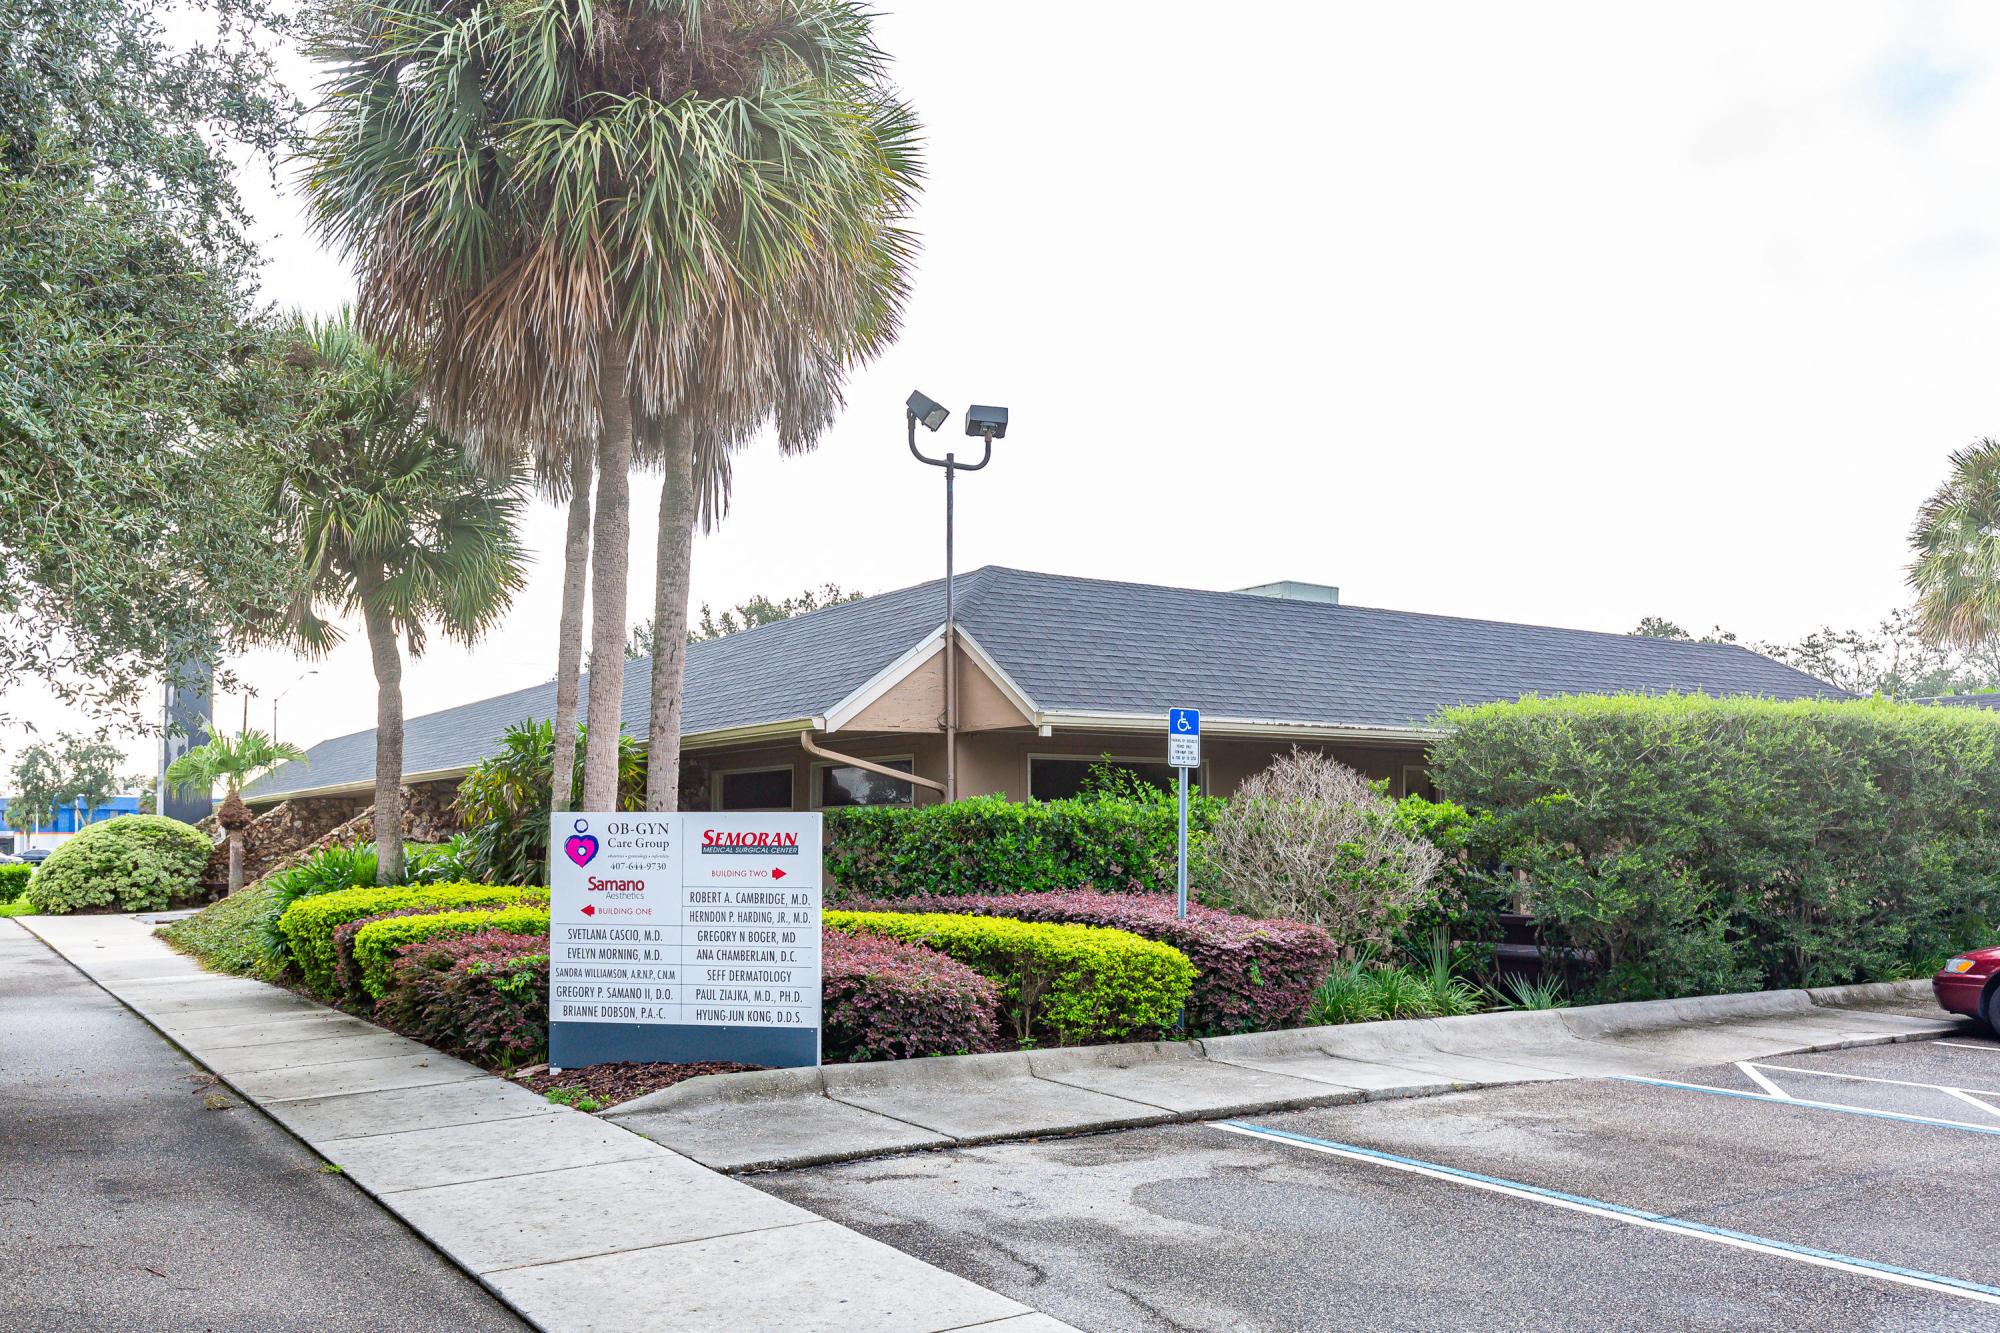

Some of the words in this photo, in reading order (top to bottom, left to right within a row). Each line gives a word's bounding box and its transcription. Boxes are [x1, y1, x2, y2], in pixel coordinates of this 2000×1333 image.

[608, 823, 669, 834] OB-GYN
[608, 838, 632, 848] Care
[636, 838, 670, 851] Group
[704, 830, 798, 846] SEMORAN
[588, 876, 644, 891] Samano
[690, 892, 722, 903] ROBERT
[724, 892, 732, 904] A.
[736, 892, 788, 906] CAMBRIDGE,
[791, 894, 810, 905] M.D.
[690, 911, 726, 922] HERNDON
[729, 912, 734, 922] P.
[738, 912, 774, 924] HARDING,
[777, 912, 790, 924] JR.,
[794, 912, 810, 924] M.D.
[568, 928, 607, 940] SVETLANA
[610, 930, 640, 942] CASCIO,
[644, 930, 662, 941] M.D.
[698, 930, 736, 942] GREGORY
[740, 931, 745, 942] N
[749, 932, 778, 944] BOGER,
[782, 932, 796, 943] MD
[568, 948, 596, 959] EVELYN
[599, 948, 640, 962] MORNING,
[644, 950, 662, 960] M.D.
[697, 949, 714, 960] ANA
[717, 950, 777, 964] CHAMBERLAIN,
[781, 951, 797, 962] D.C.
[556, 968, 582, 978] SANDRA
[585, 968, 629, 980] WILLIAMSON,
[707, 970, 726, 980] SEFF
[729, 970, 792, 982] DERMATOLOGY
[556, 986, 594, 998] GREGORY
[598, 987, 604, 998] P.
[607, 987, 641, 999] SAMANO
[656, 989, 673, 1000] D.O.
[696, 989, 716, 1000] PAUL
[720, 990, 750, 1002] ZIAJKA,
[754, 990, 776, 1004] M.D.,
[780, 991, 802, 1002] PH.D.
[563, 1005, 598, 1017] BRIANNE
[602, 1006, 638, 1020] DOBSON,
[696, 1010, 744, 1021] HYUNG-JUN
[748, 1011, 774, 1024] KONG,
[778, 1012, 802, 1023] D.D.S.
